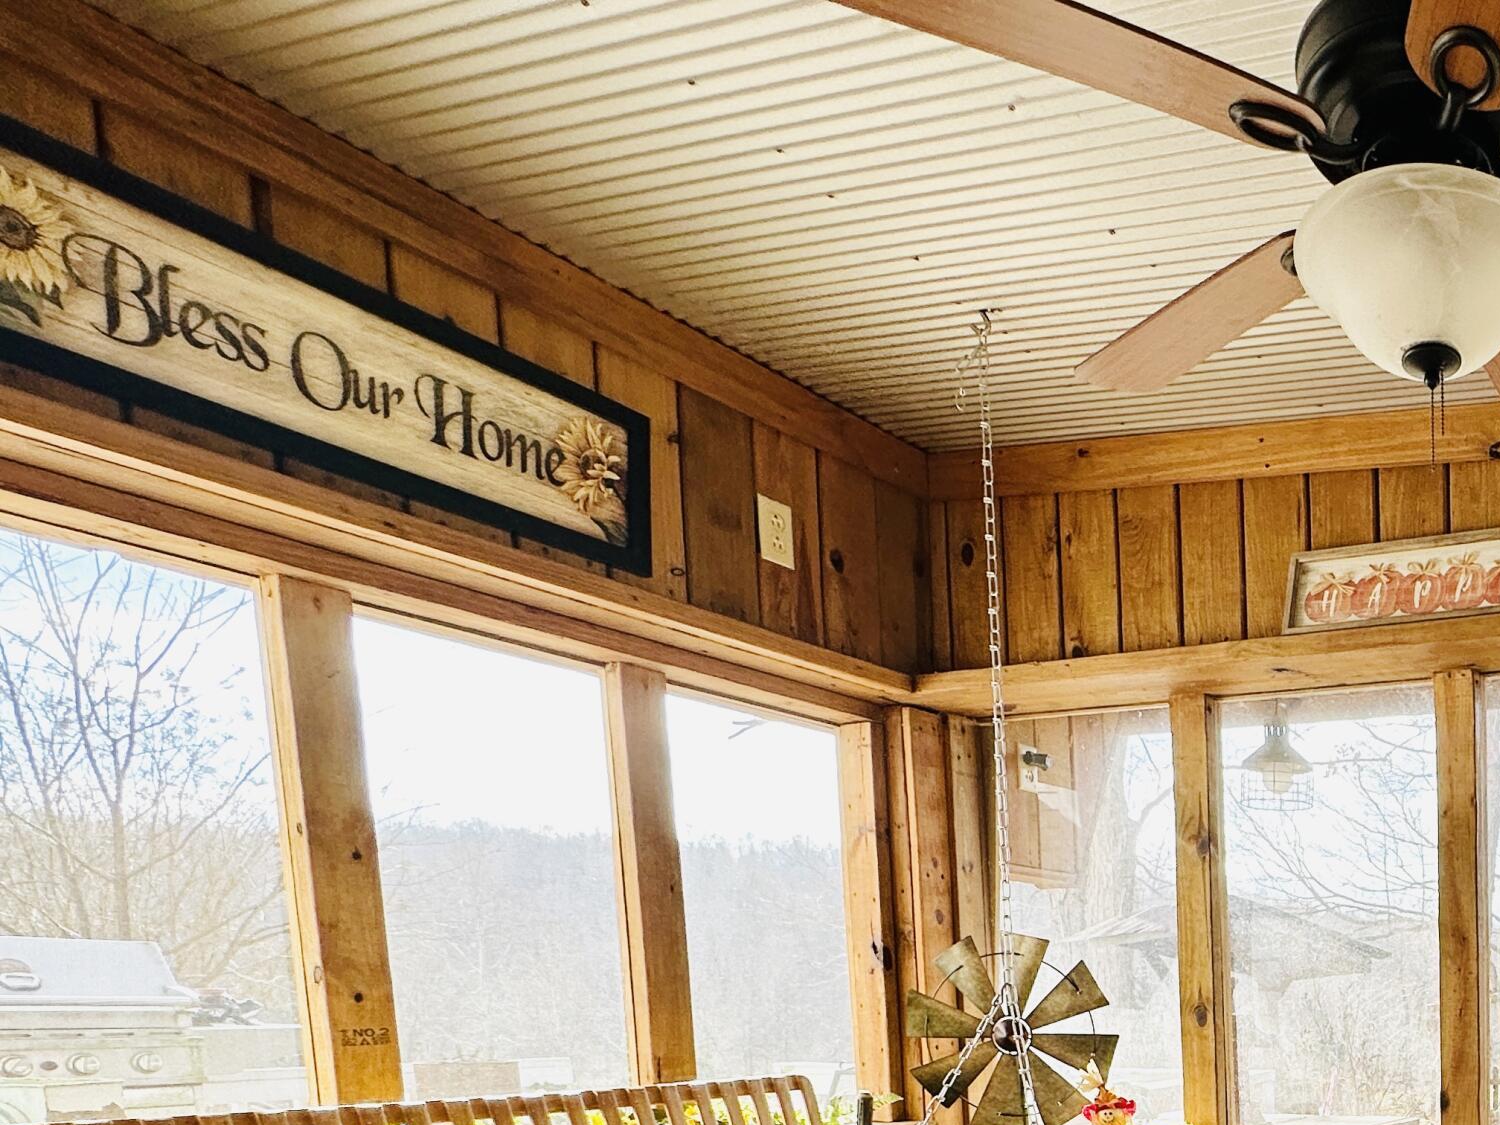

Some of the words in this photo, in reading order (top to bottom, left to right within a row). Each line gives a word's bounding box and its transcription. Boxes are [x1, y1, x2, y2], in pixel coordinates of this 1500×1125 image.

[61, 232, 270, 373] Bless
[290, 330, 405, 419] Our
[414, 373, 567, 487] Home
